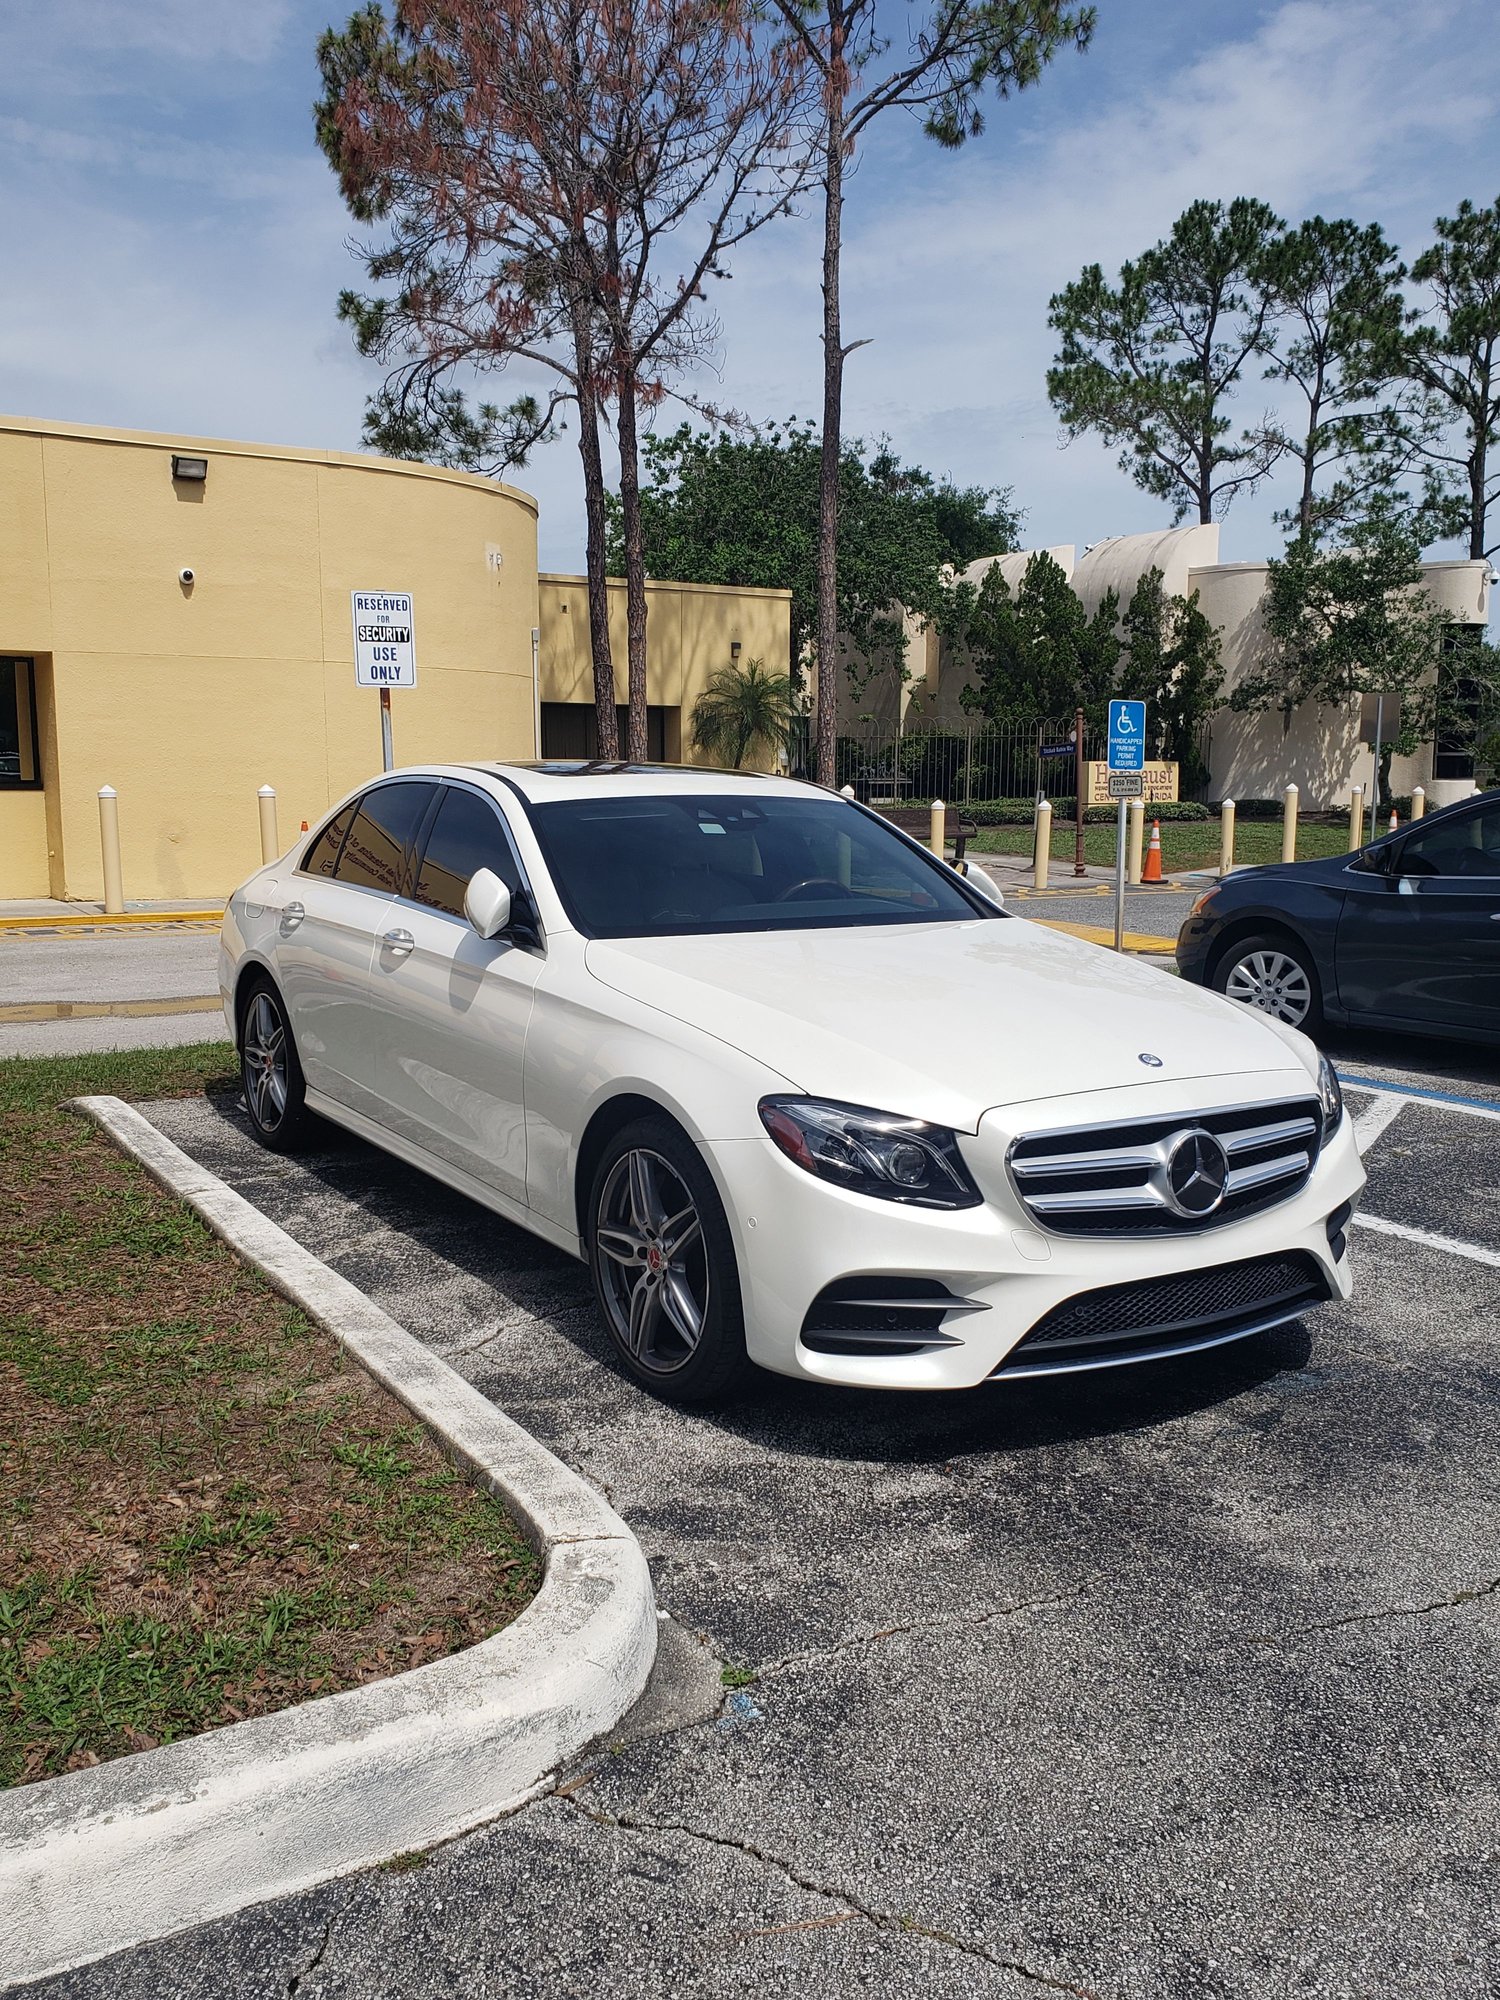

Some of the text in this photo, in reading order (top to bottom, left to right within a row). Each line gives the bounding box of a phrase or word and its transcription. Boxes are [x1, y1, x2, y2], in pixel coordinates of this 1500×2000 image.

[357, 597, 408, 611] RESERVED
[376, 615, 390, 623] FOR
[359, 626, 409, 641] SECURITY
[373, 647, 397, 661] USE
[370, 665, 401, 680] ONLY
[1126, 778, 1139, 786] FINE
